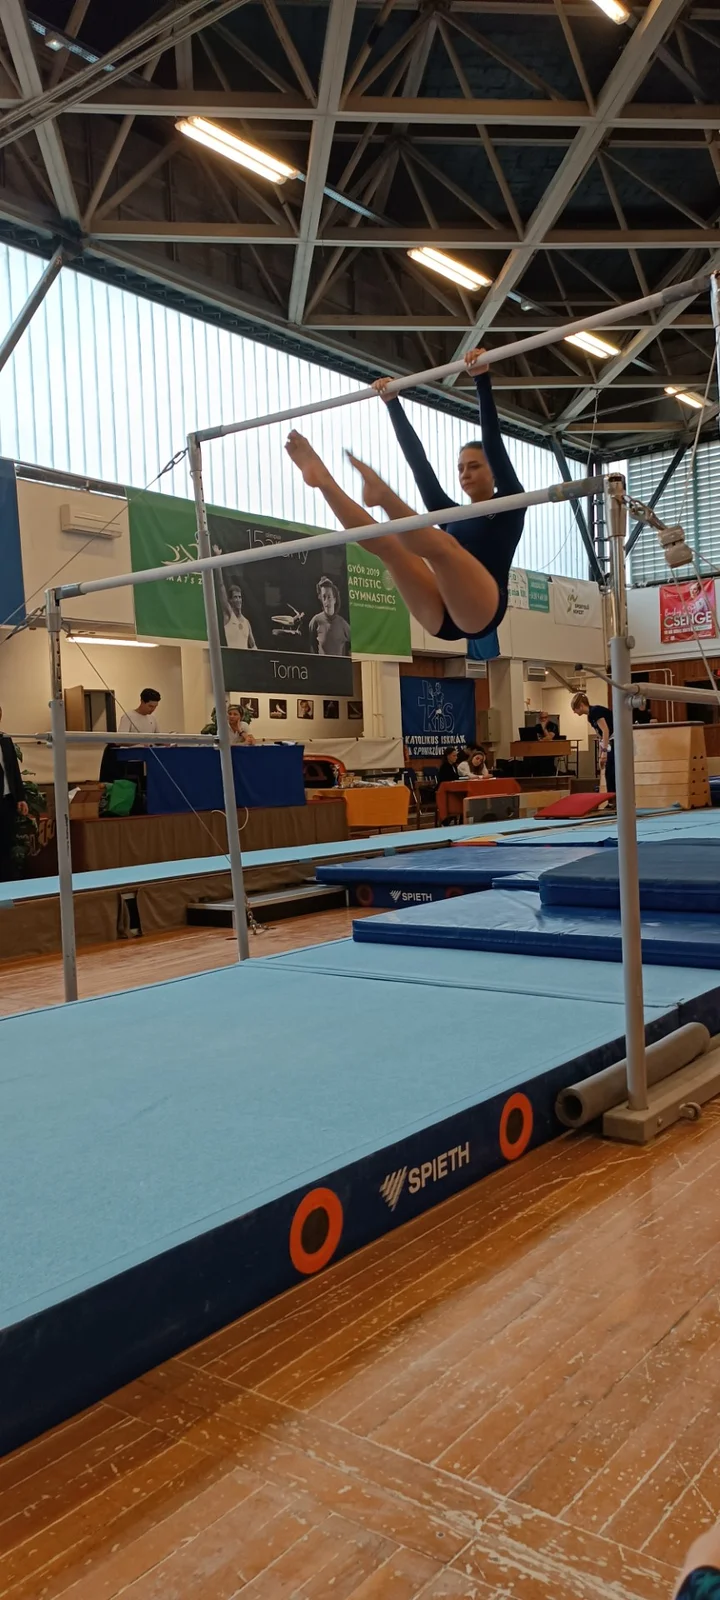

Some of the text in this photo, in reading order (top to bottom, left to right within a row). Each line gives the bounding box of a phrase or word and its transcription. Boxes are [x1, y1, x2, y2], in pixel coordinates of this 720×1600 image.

[366, 567, 380, 577] 2019
[347, 576, 382, 590] ARTISTIC
[348, 589, 396, 605] GYMNASTICS
[663, 611, 713, 628] CSENGE
[269, 659, 309, 680] Torna
[404, 735, 439, 745] KATOLIKUS
[401, 891, 433, 902] SPIETH
[407, 1141, 470, 1194] SPIETH
